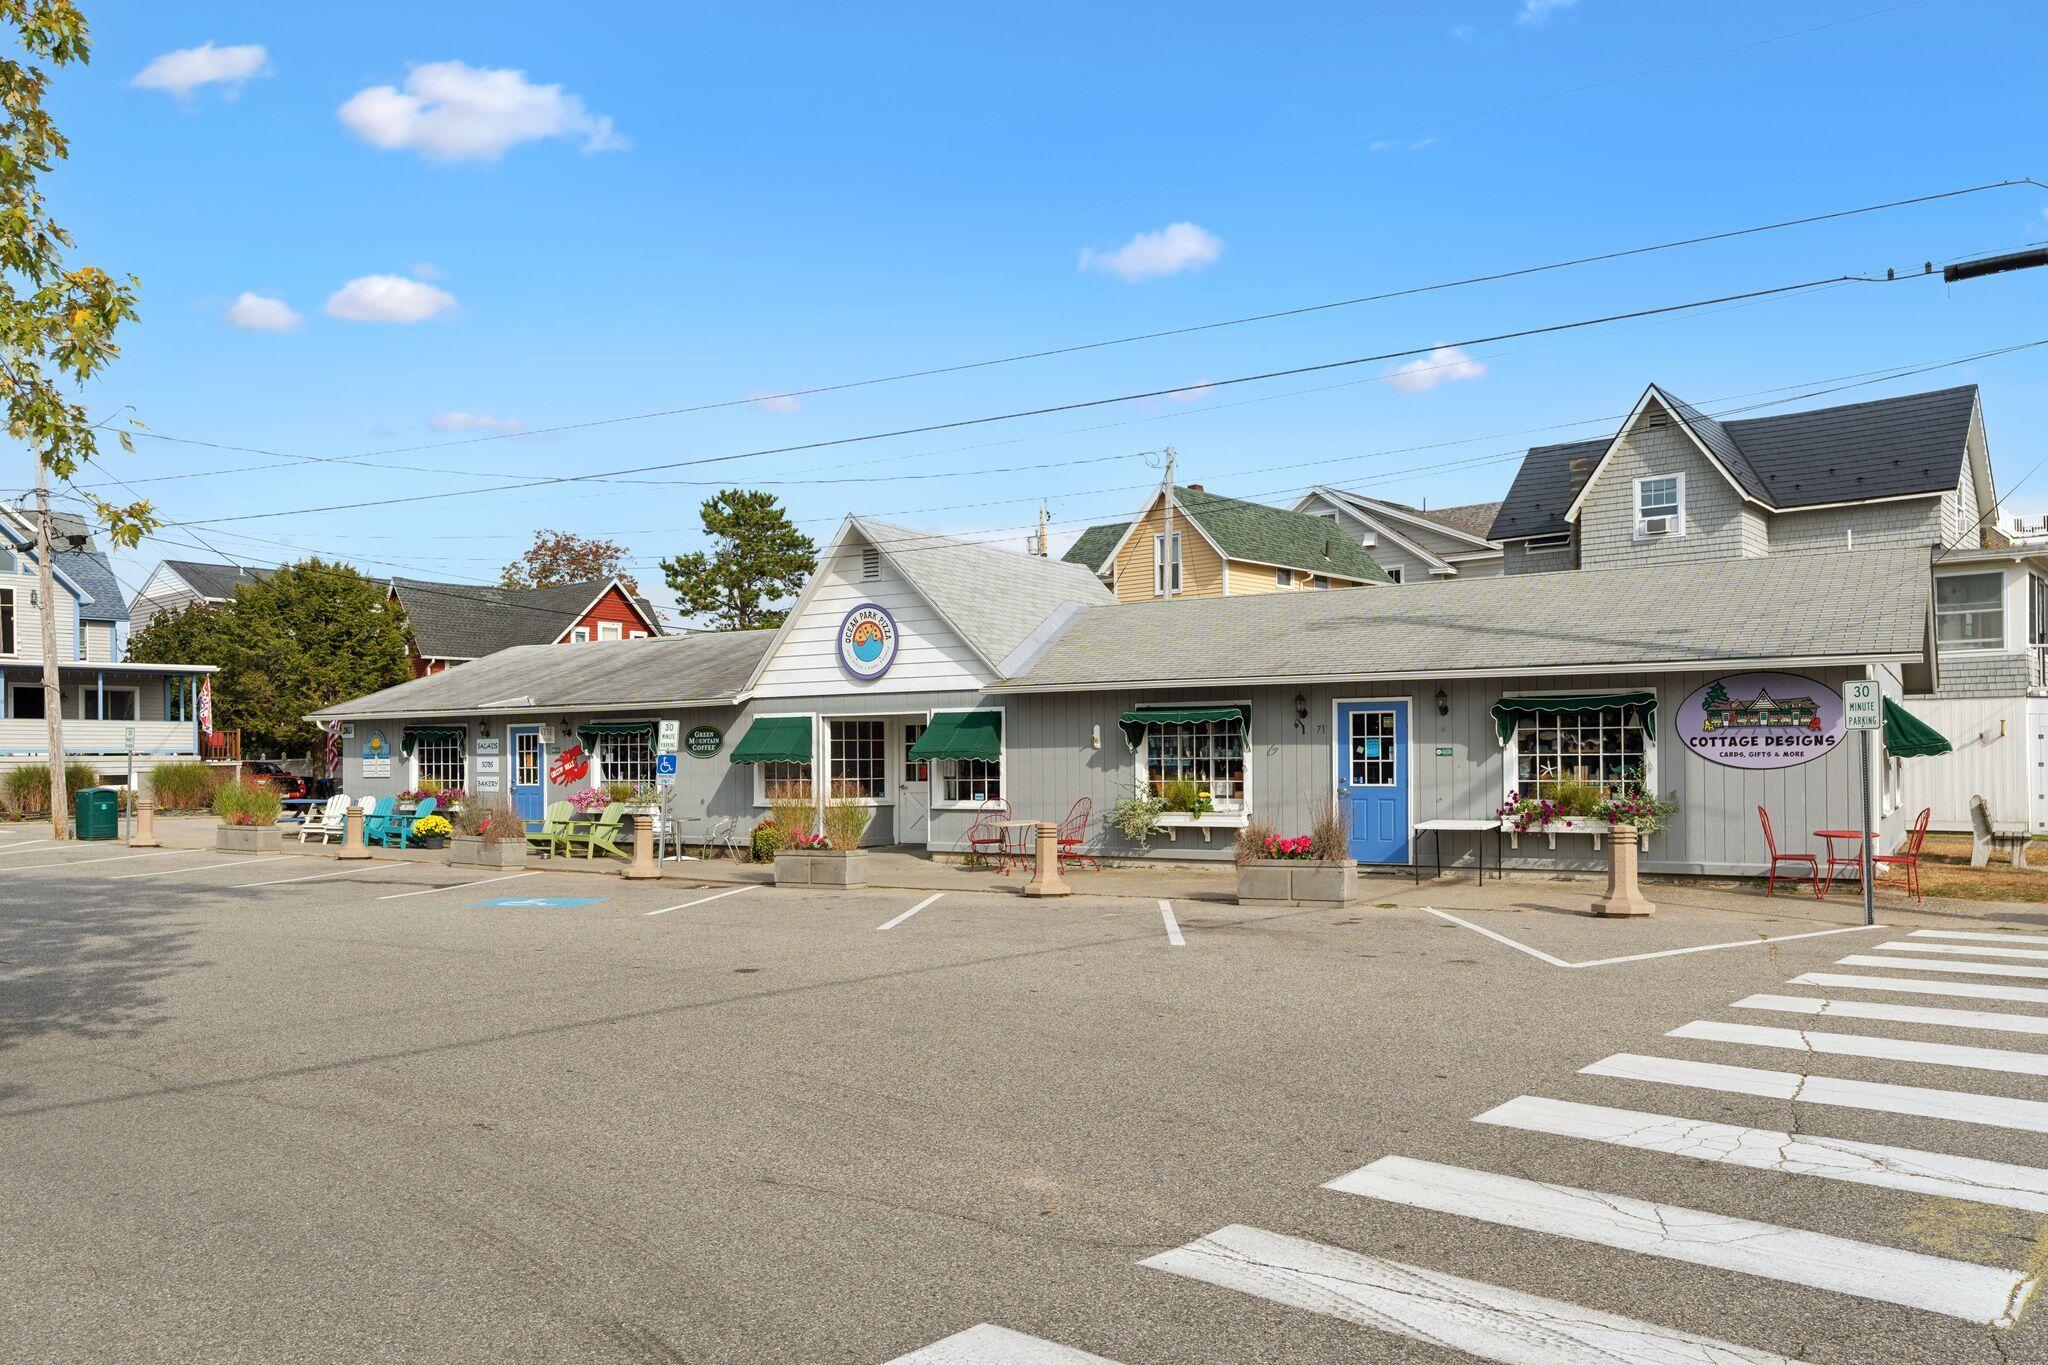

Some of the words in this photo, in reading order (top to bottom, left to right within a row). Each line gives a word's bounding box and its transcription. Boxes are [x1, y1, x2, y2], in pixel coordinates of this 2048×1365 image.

[846, 616, 858, 644] OCEAN
[860, 611, 878, 620] PARK
[878, 616, 892, 640] PIZZA
[1854, 685, 1870, 698] 30
[1850, 702, 1874, 711] MINUTE
[1848, 716, 1876, 725] PARKING
[664, 723, 674, 732] 30
[1317, 724, 1325, 734] 71
[1690, 736, 1758, 747] COTTAGE
[1764, 735, 1836, 747] DESIGNS
